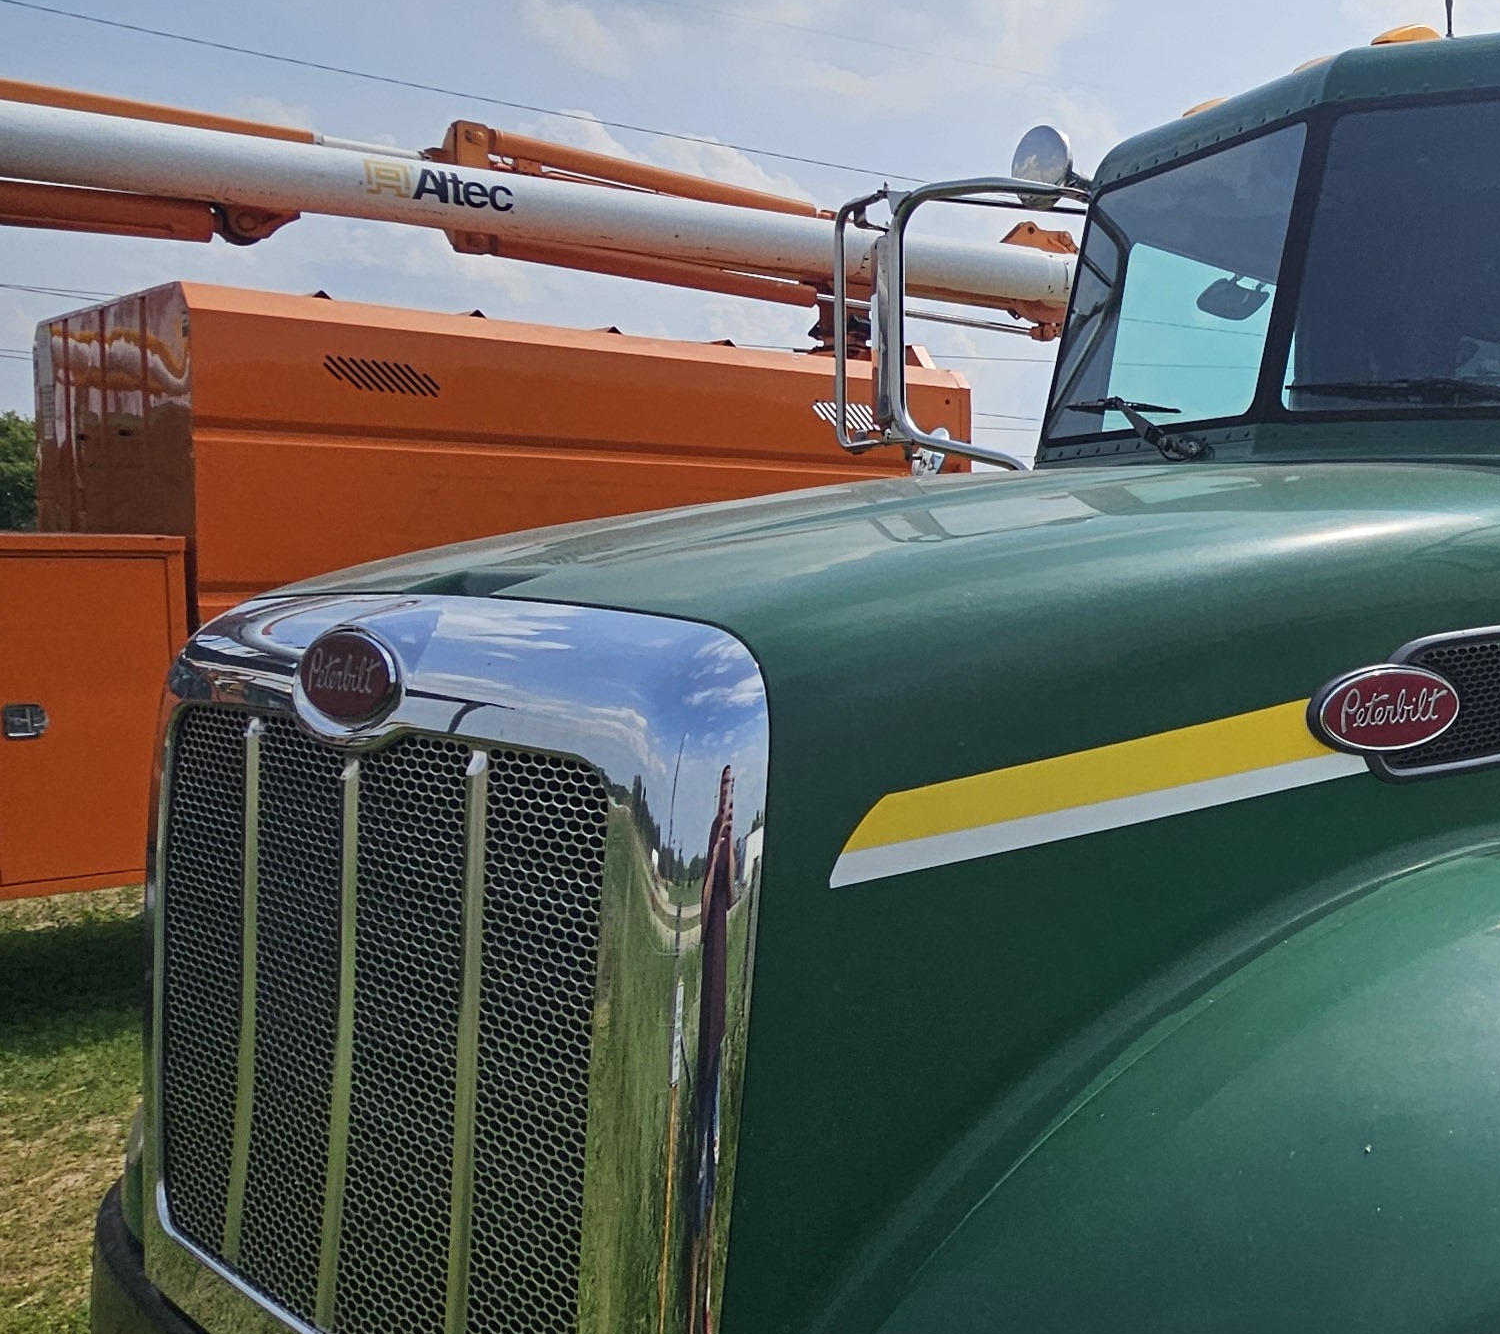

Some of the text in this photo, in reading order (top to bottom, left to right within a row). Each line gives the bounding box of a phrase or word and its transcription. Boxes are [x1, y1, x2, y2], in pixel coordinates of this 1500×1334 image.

[412, 168, 514, 212] Altec
[308, 647, 382, 694] Peterbilt
[1340, 688, 1448, 734] Peterbilt
